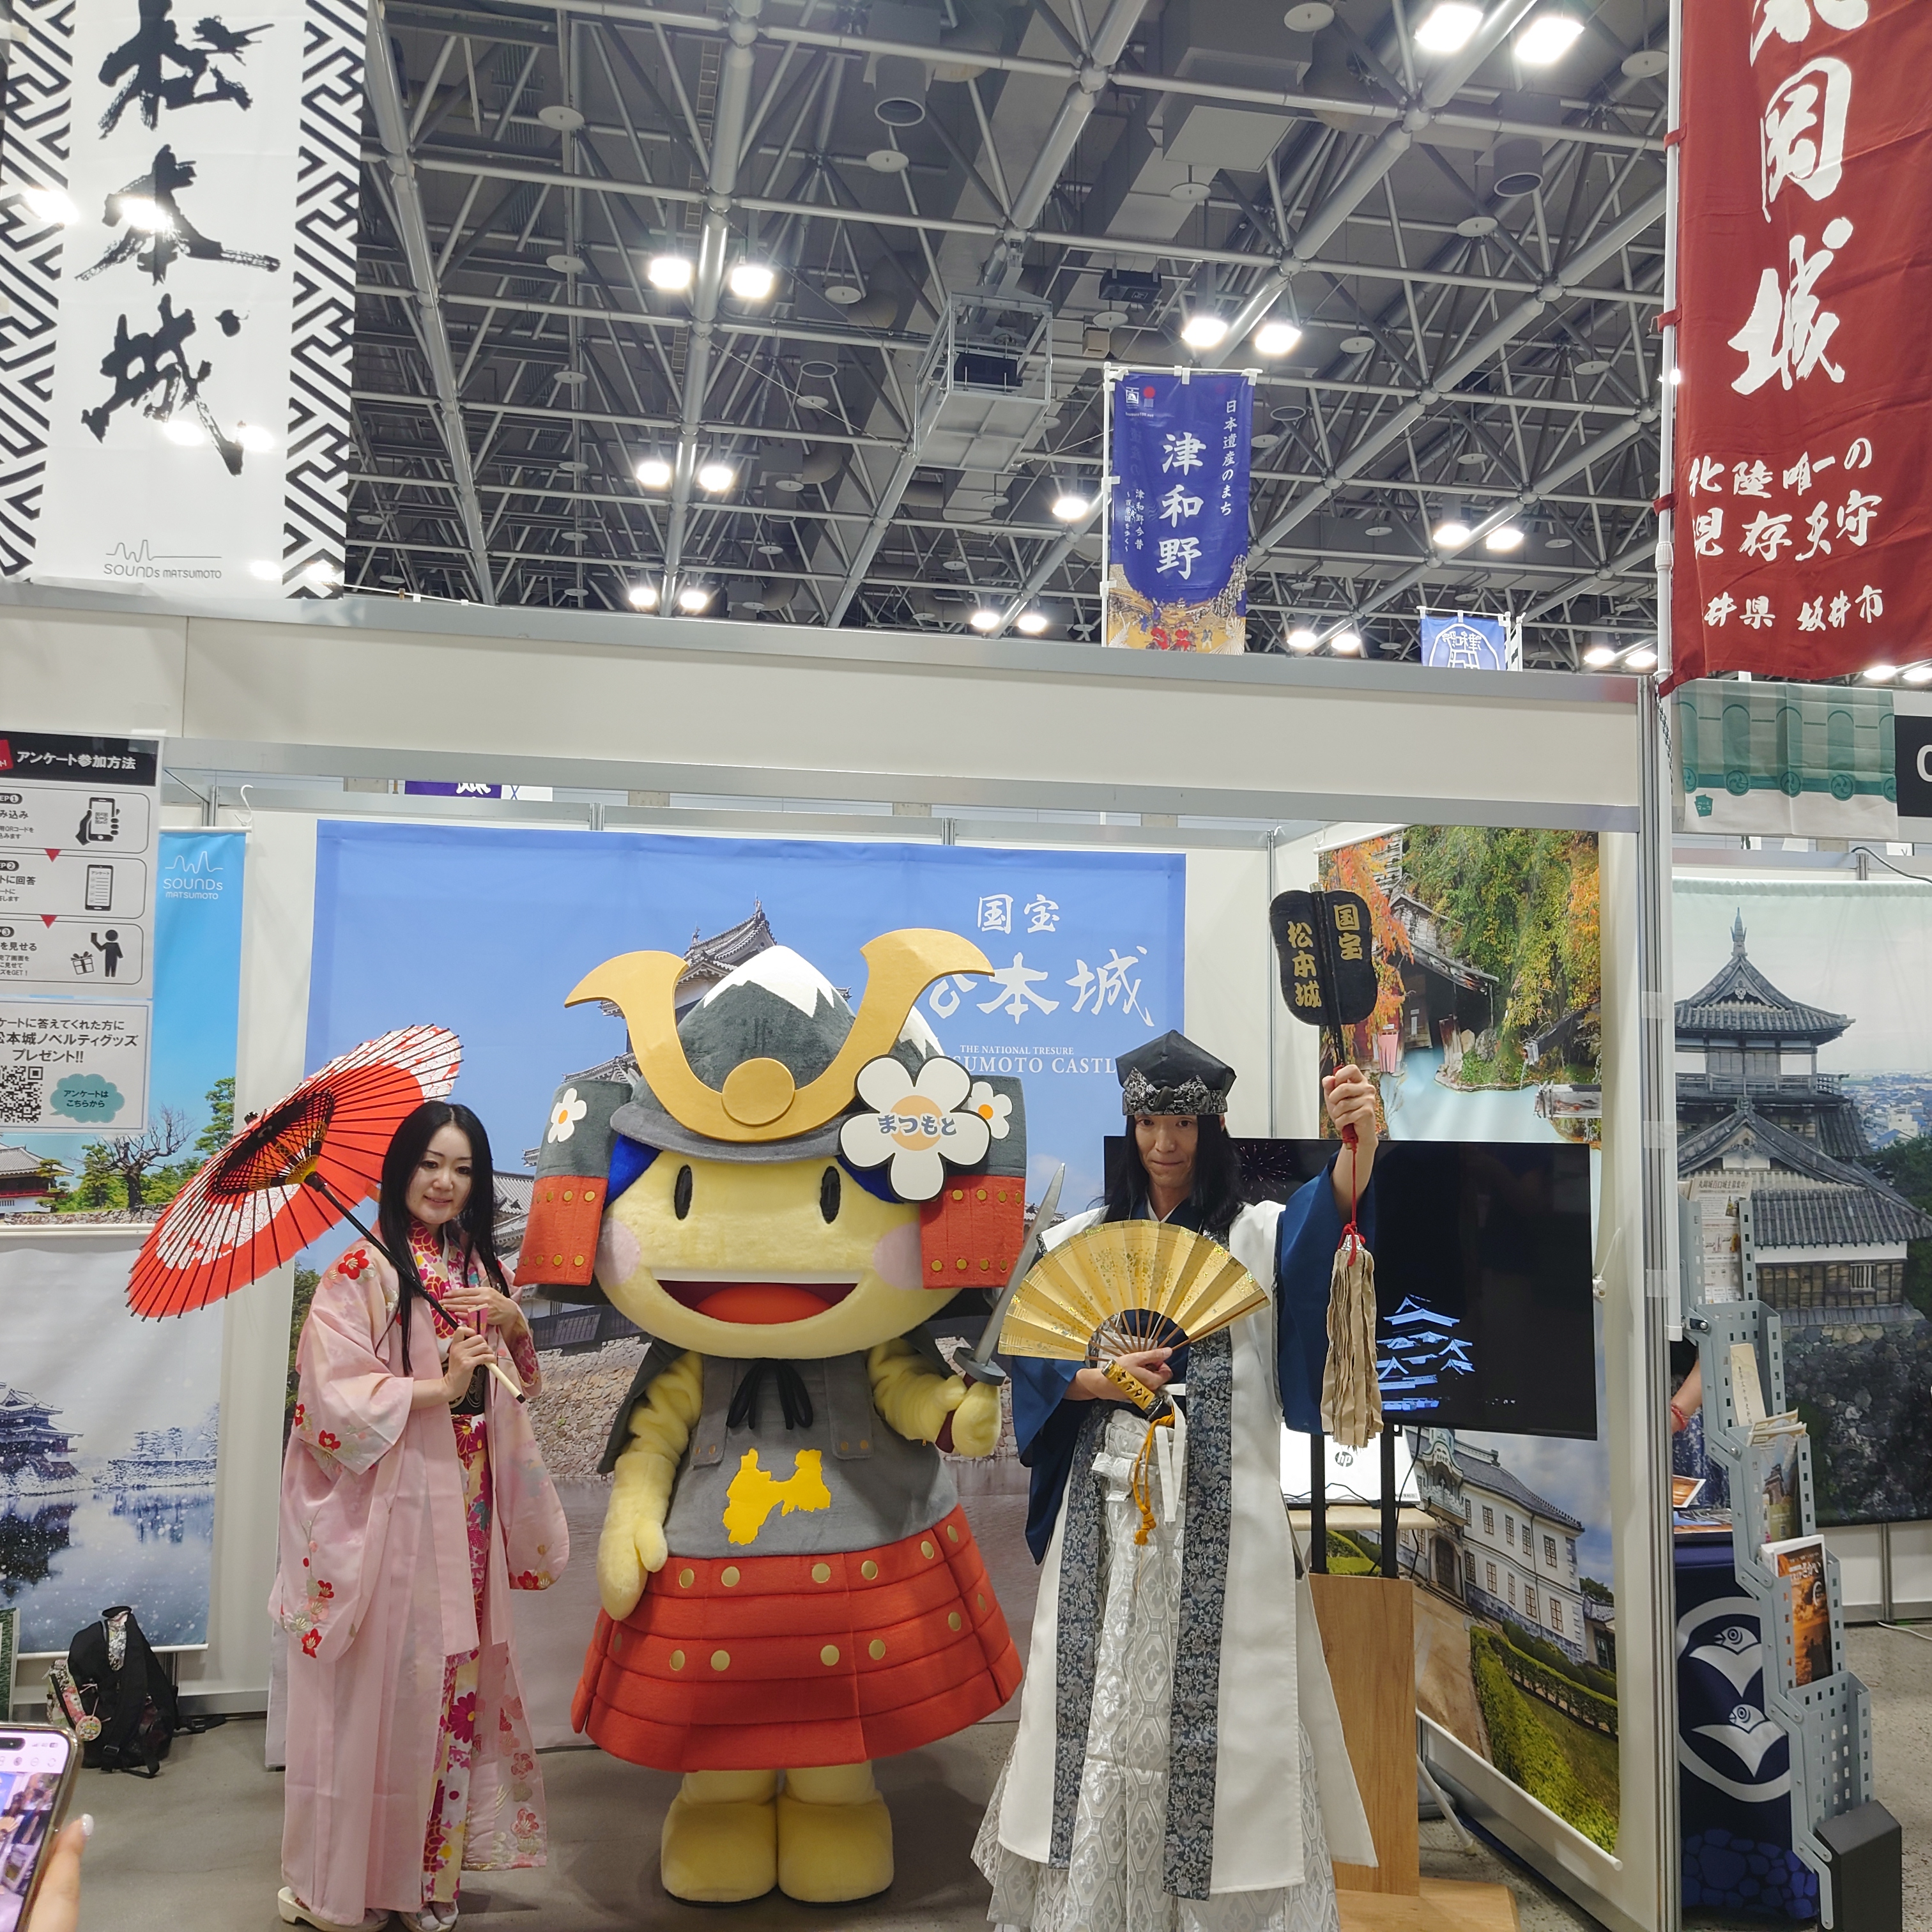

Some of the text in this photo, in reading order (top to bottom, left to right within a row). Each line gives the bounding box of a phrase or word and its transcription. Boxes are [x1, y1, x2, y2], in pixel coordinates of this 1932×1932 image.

[1221, 399, 1238, 516] 日本遺産のまち
[1156, 432, 1207, 581] 津和野
[1135, 489, 1145, 550] 津和野今昔
[162, 569, 222, 578] MATSUMOTO
[17, 751, 137, 770] アンケート参加方法
[166, 891, 218, 900] MATSUMOTO
[977, 894, 1060, 934] 国宝
[1333, 903, 1363, 960] 国宝
[1, 942, 37, 951] を見せる
[1287, 920, 1322, 1008] 松本城
[960, 1045, 1074, 1055] THE NATIONAL TRESURE
[947, 1055, 1043, 1073] UMOTO
[66, 1100, 105, 1108] こちらから
[877, 1114, 957, 1136] まつもと
[1336, 1451, 1353, 1468] hp
